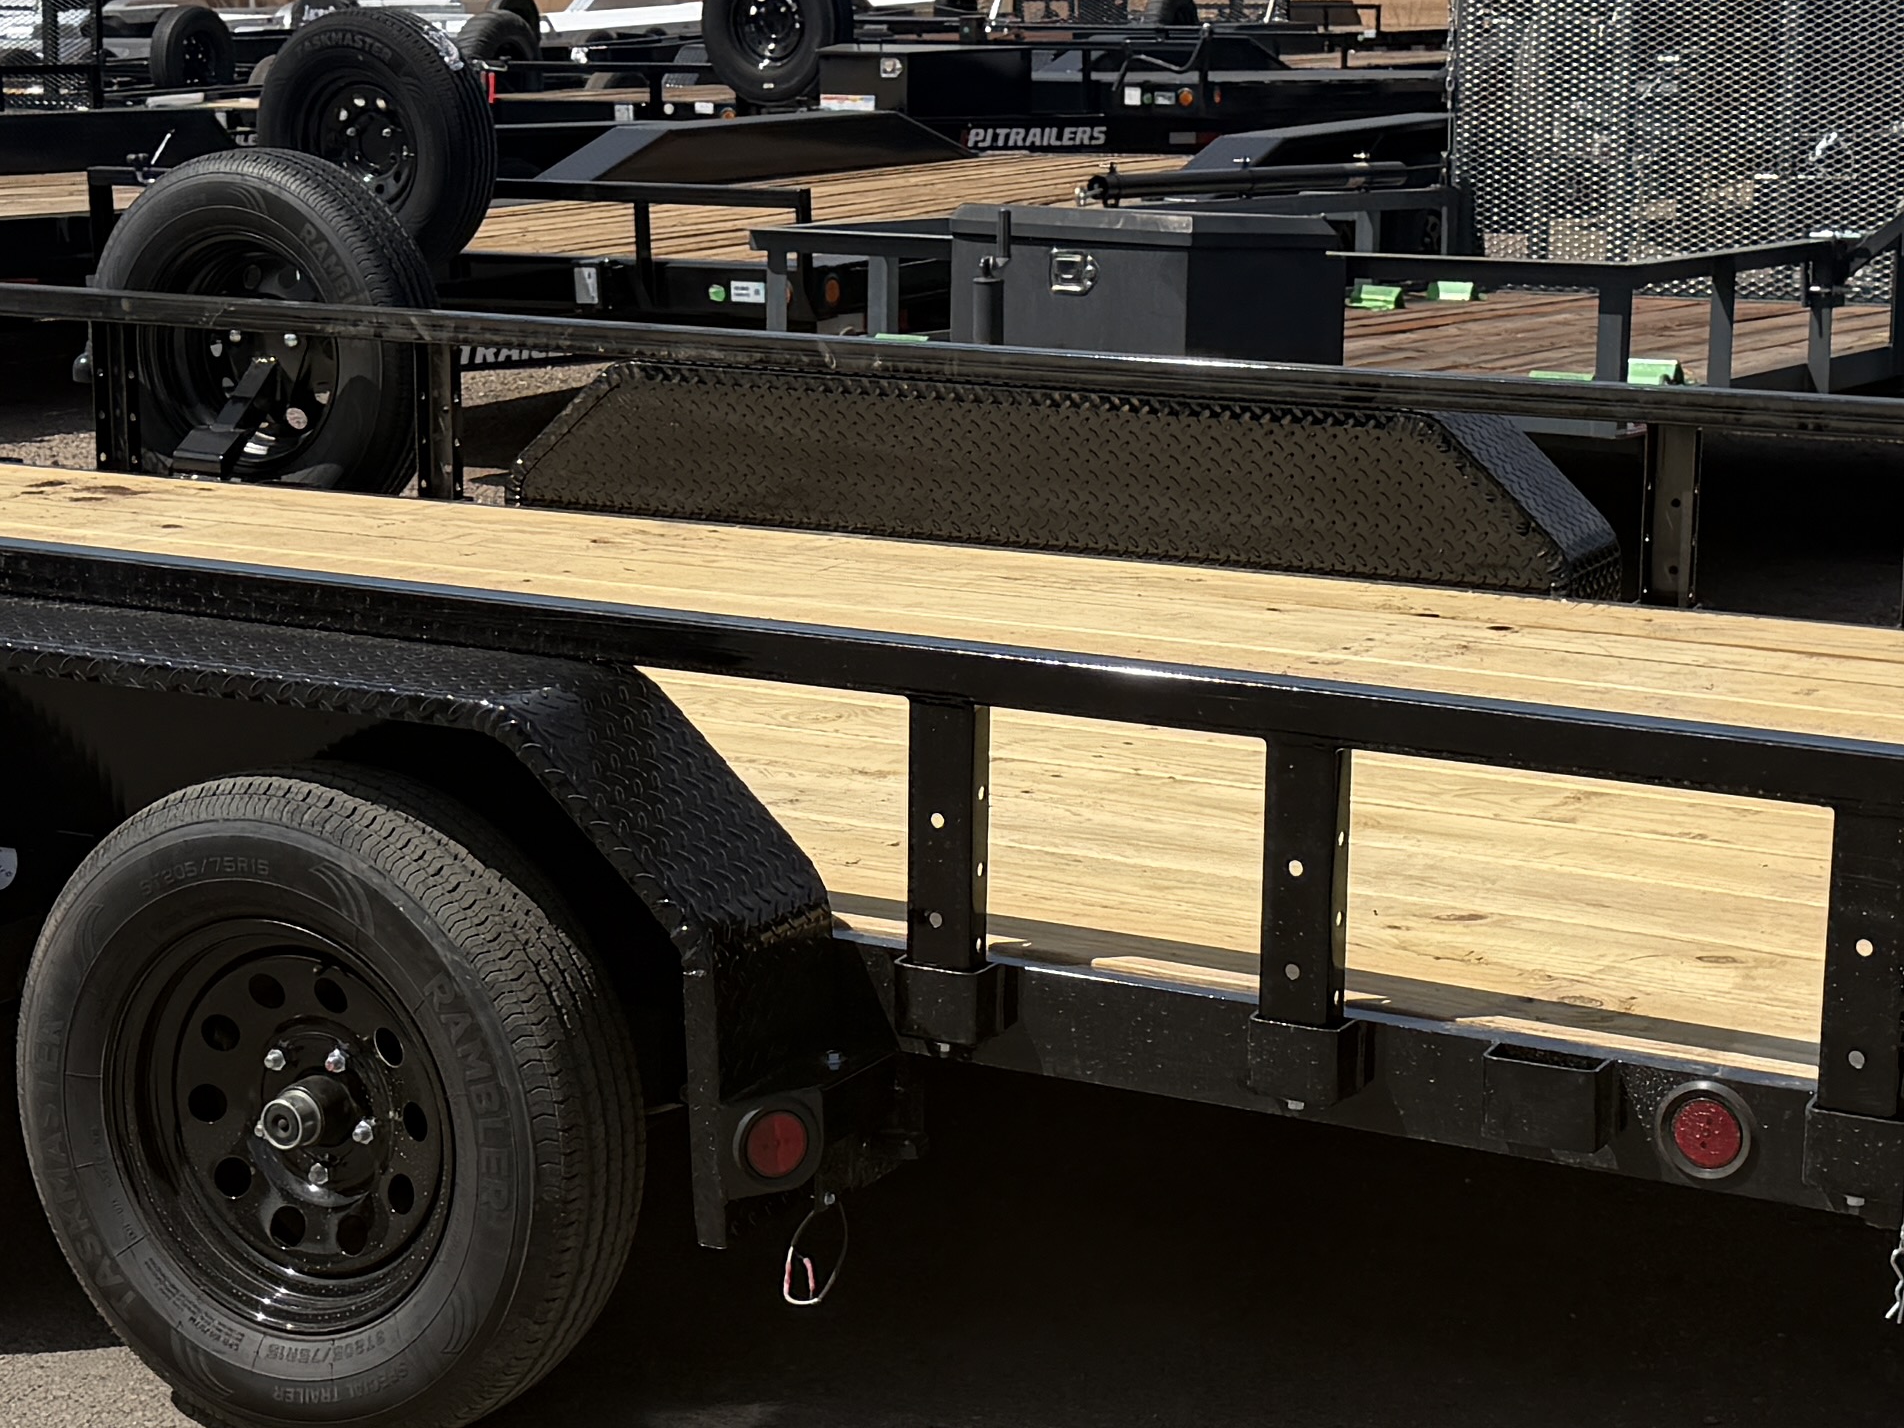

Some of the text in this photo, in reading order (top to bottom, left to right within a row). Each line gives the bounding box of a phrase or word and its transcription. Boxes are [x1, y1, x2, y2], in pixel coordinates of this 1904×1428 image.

[967, 126, 1107, 148] PJ TRAILERS
[139, 856, 271, 896] ST205/75R15
[423, 972, 512, 1212] RAMBLER
